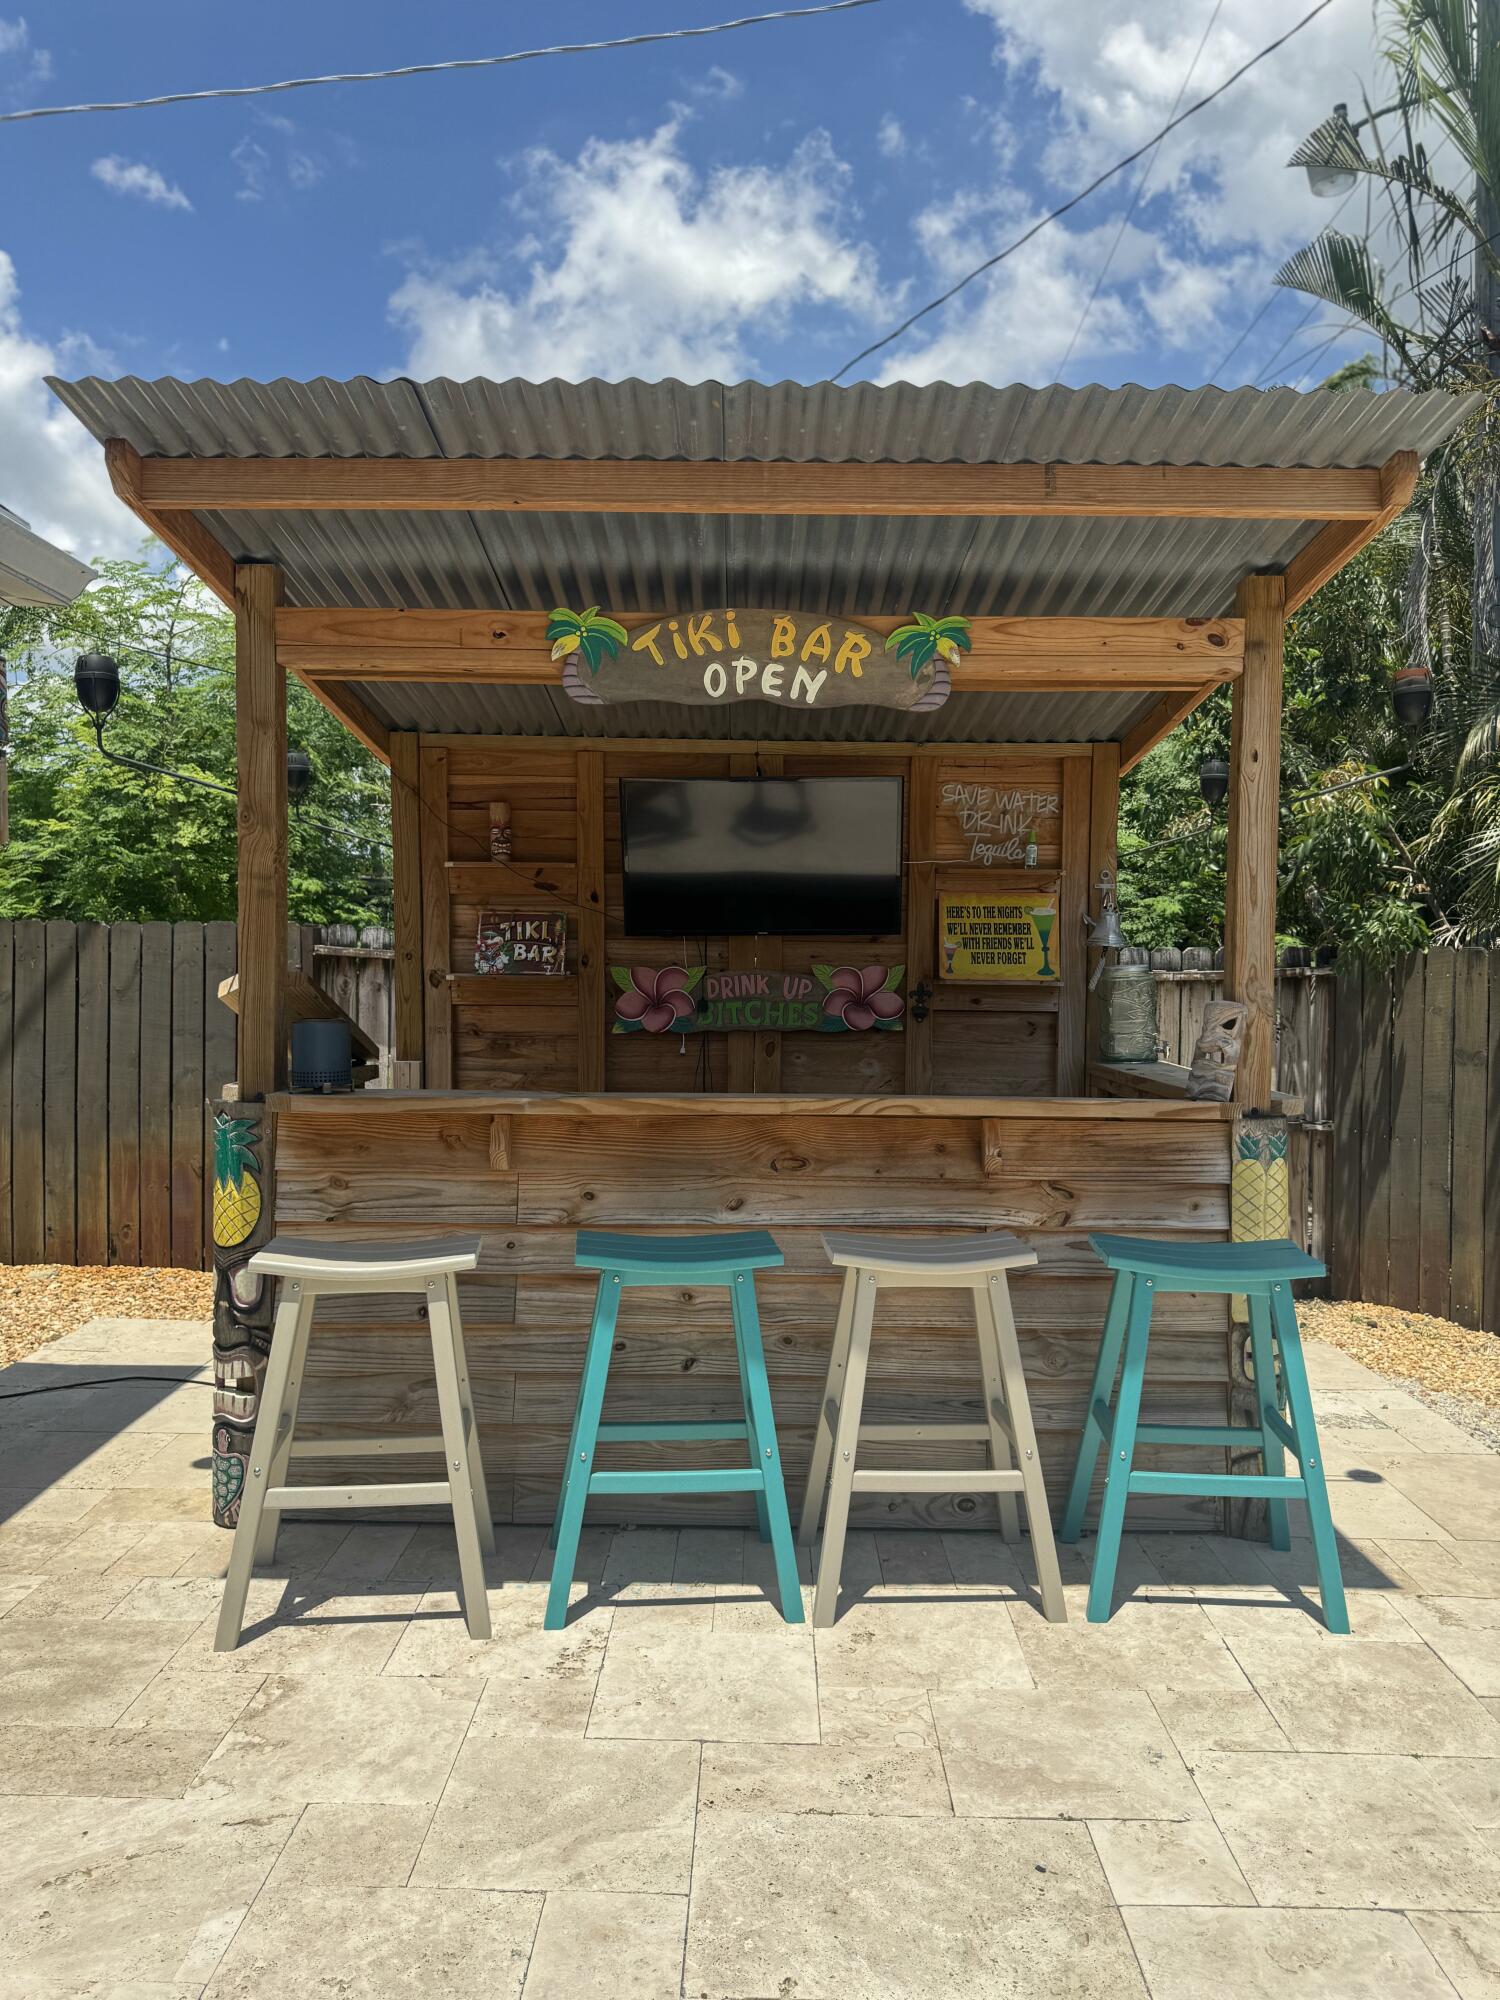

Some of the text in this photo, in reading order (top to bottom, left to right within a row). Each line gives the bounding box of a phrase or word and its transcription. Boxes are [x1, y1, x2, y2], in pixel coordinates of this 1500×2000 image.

[771, 615, 872, 678] BAR
[703, 656, 828, 704] OPEN
[942, 784, 1059, 815] SAVE WATER
[960, 808, 1033, 836] DRINK
[964, 833, 1025, 865] Tequila
[946, 906, 1023, 919] HERE'S TO THE NIGHTS
[500, 920, 549, 941] TIKI
[947, 923, 1031, 935] WE'LL NEVER REMEMBER
[514, 944, 557, 963] BAR
[962, 937, 1034, 950] WITH FRIENDS WE'LL
[971, 952, 1027, 964] NEVER FORGET
[707, 975, 813, 1000] DRINK UP
